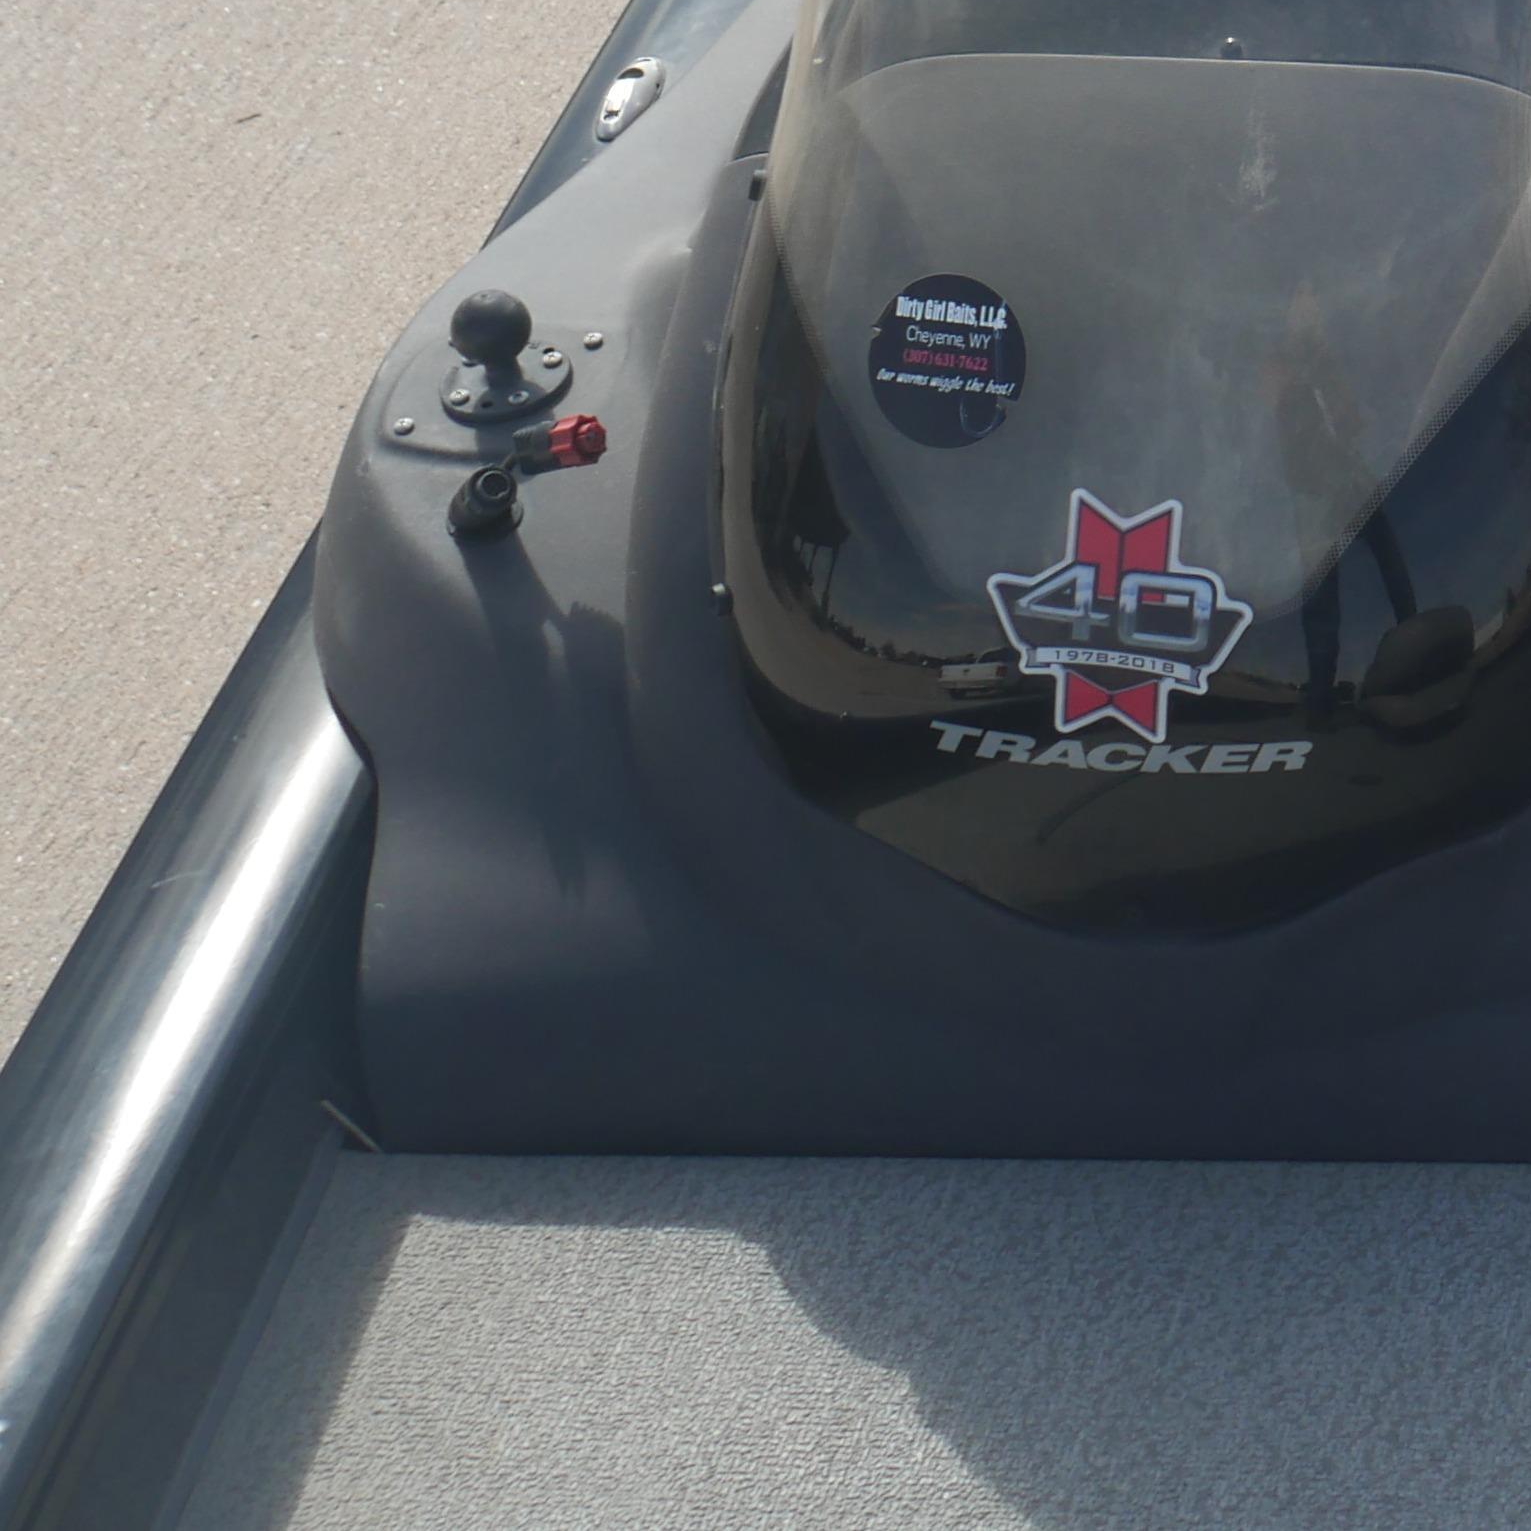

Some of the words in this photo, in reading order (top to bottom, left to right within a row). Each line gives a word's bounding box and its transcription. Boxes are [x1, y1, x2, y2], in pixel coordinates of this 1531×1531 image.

[896, 296, 924, 321] Dirty
[925, 299, 945, 322] Girl
[906, 325, 965, 350] Cheyenne,
[969, 333, 992, 350] WY
[877, 368, 895, 380] Our
[896, 371, 929, 386] worms
[930, 375, 963, 393] wiggle
[965, 377, 984, 392] the
[985, 380, 1016, 396] best!
[1014, 563, 1214, 652] 40
[1054, 649, 1175, 675] 1978-2018
[929, 720, 1313, 774] TRACKER
